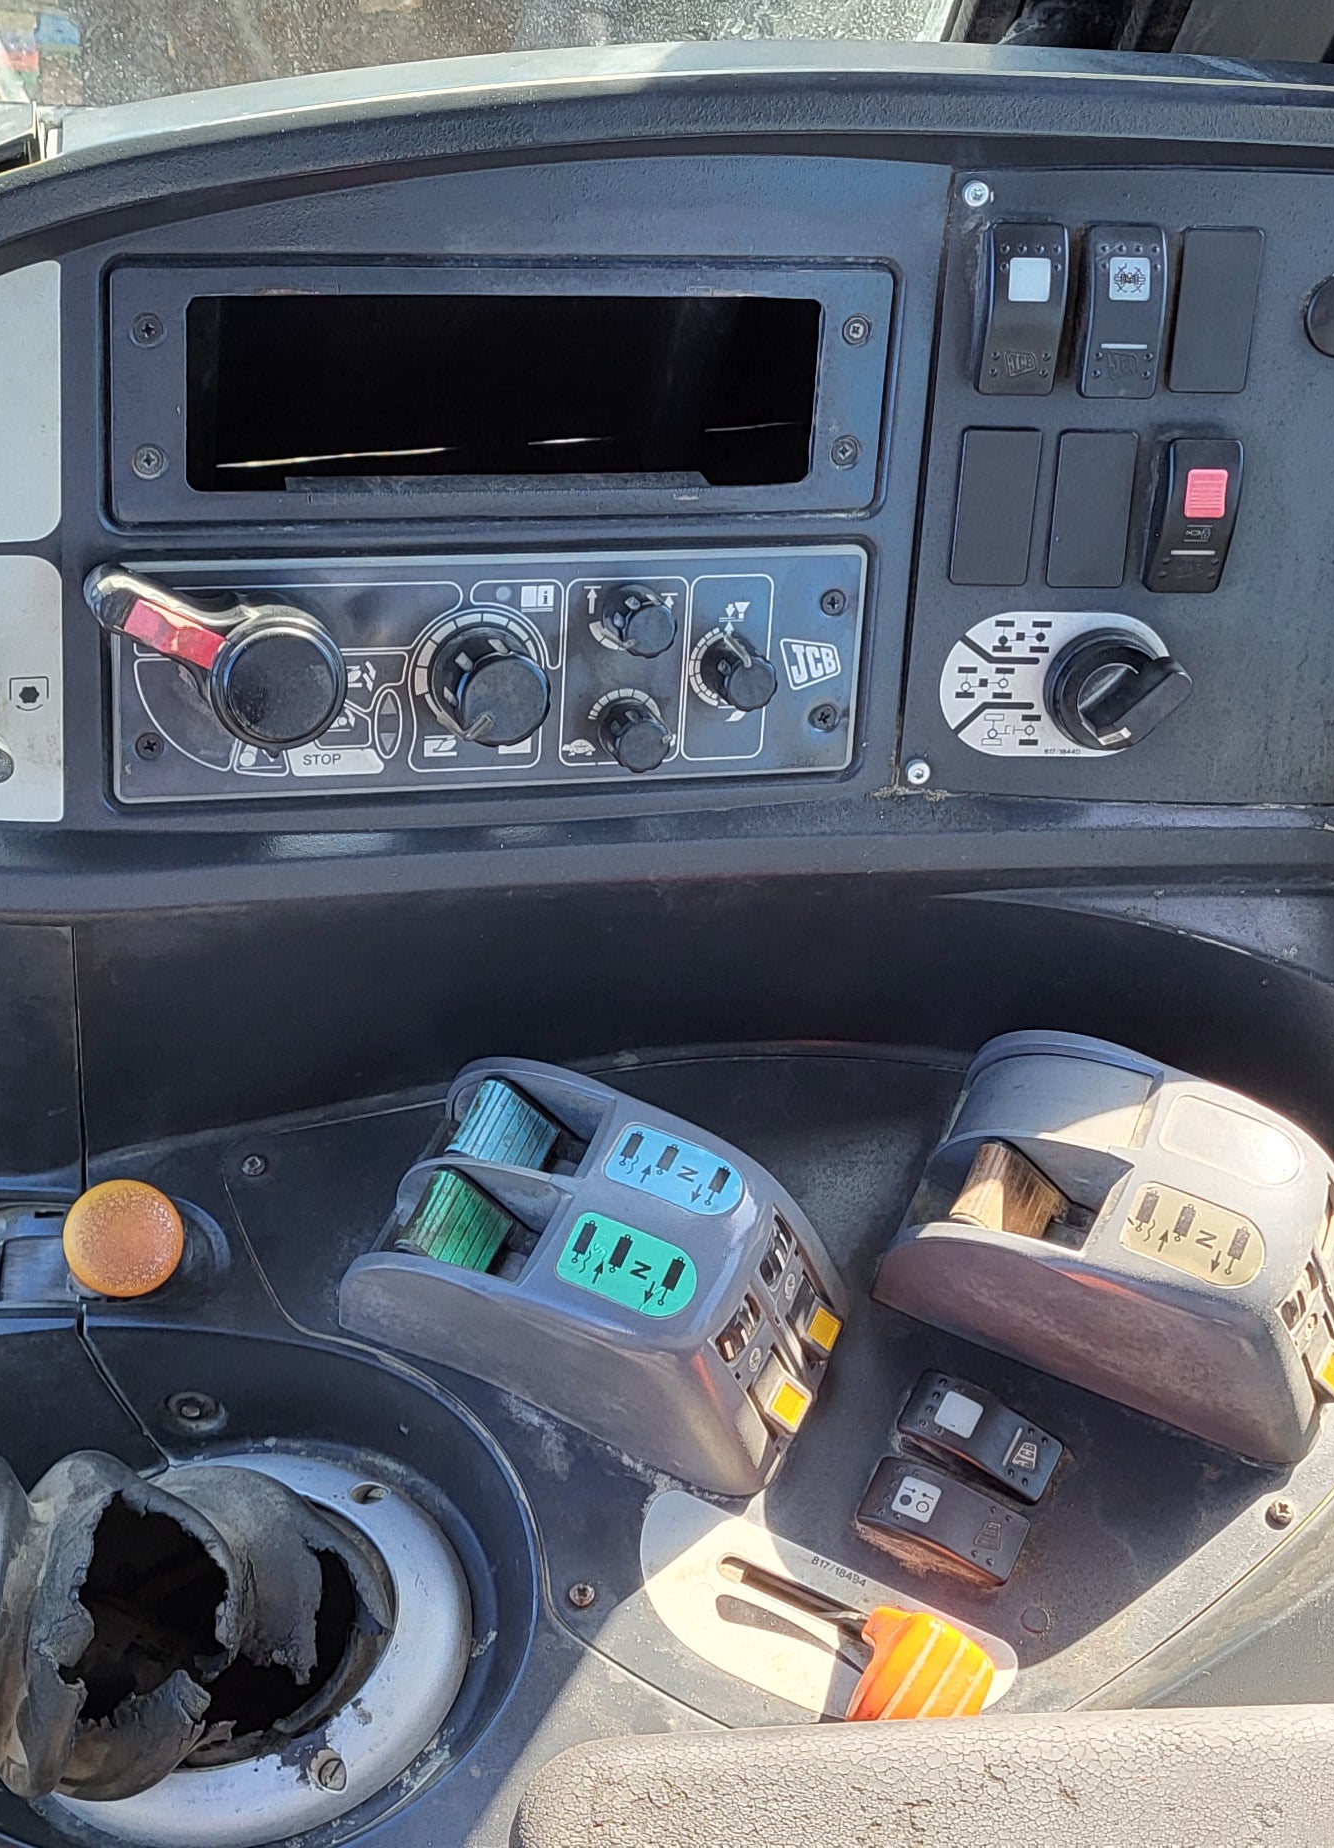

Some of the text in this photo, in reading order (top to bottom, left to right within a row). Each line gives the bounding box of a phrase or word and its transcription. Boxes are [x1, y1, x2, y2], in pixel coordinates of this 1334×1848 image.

[790, 644, 837, 684] JCB
[302, 753, 342, 766] STOP
[1013, 1443, 1036, 1469] JCB
[811, 1555, 867, 1588] 817/18494
